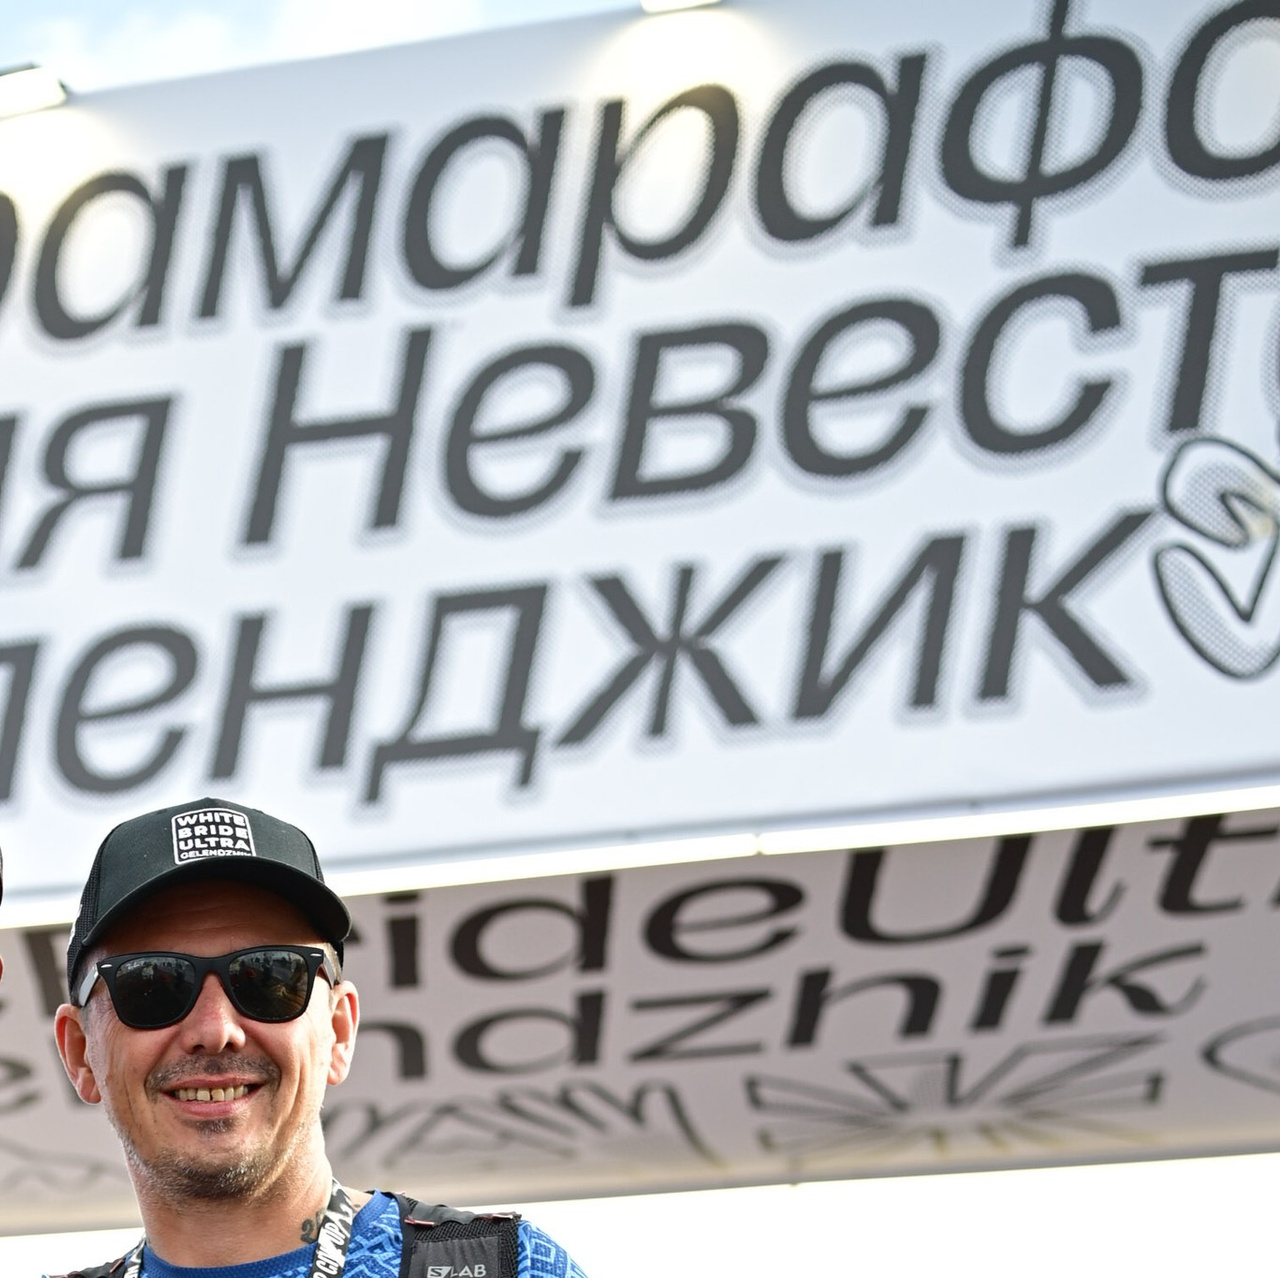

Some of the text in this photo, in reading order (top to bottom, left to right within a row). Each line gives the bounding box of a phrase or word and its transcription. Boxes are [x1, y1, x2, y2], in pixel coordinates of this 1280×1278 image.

[242, 248, 1280, 545] Невест
[177, 812, 246, 827] WHITE
[177, 825, 249, 839] BRIDE
[178, 837, 251, 851] ULTRA
